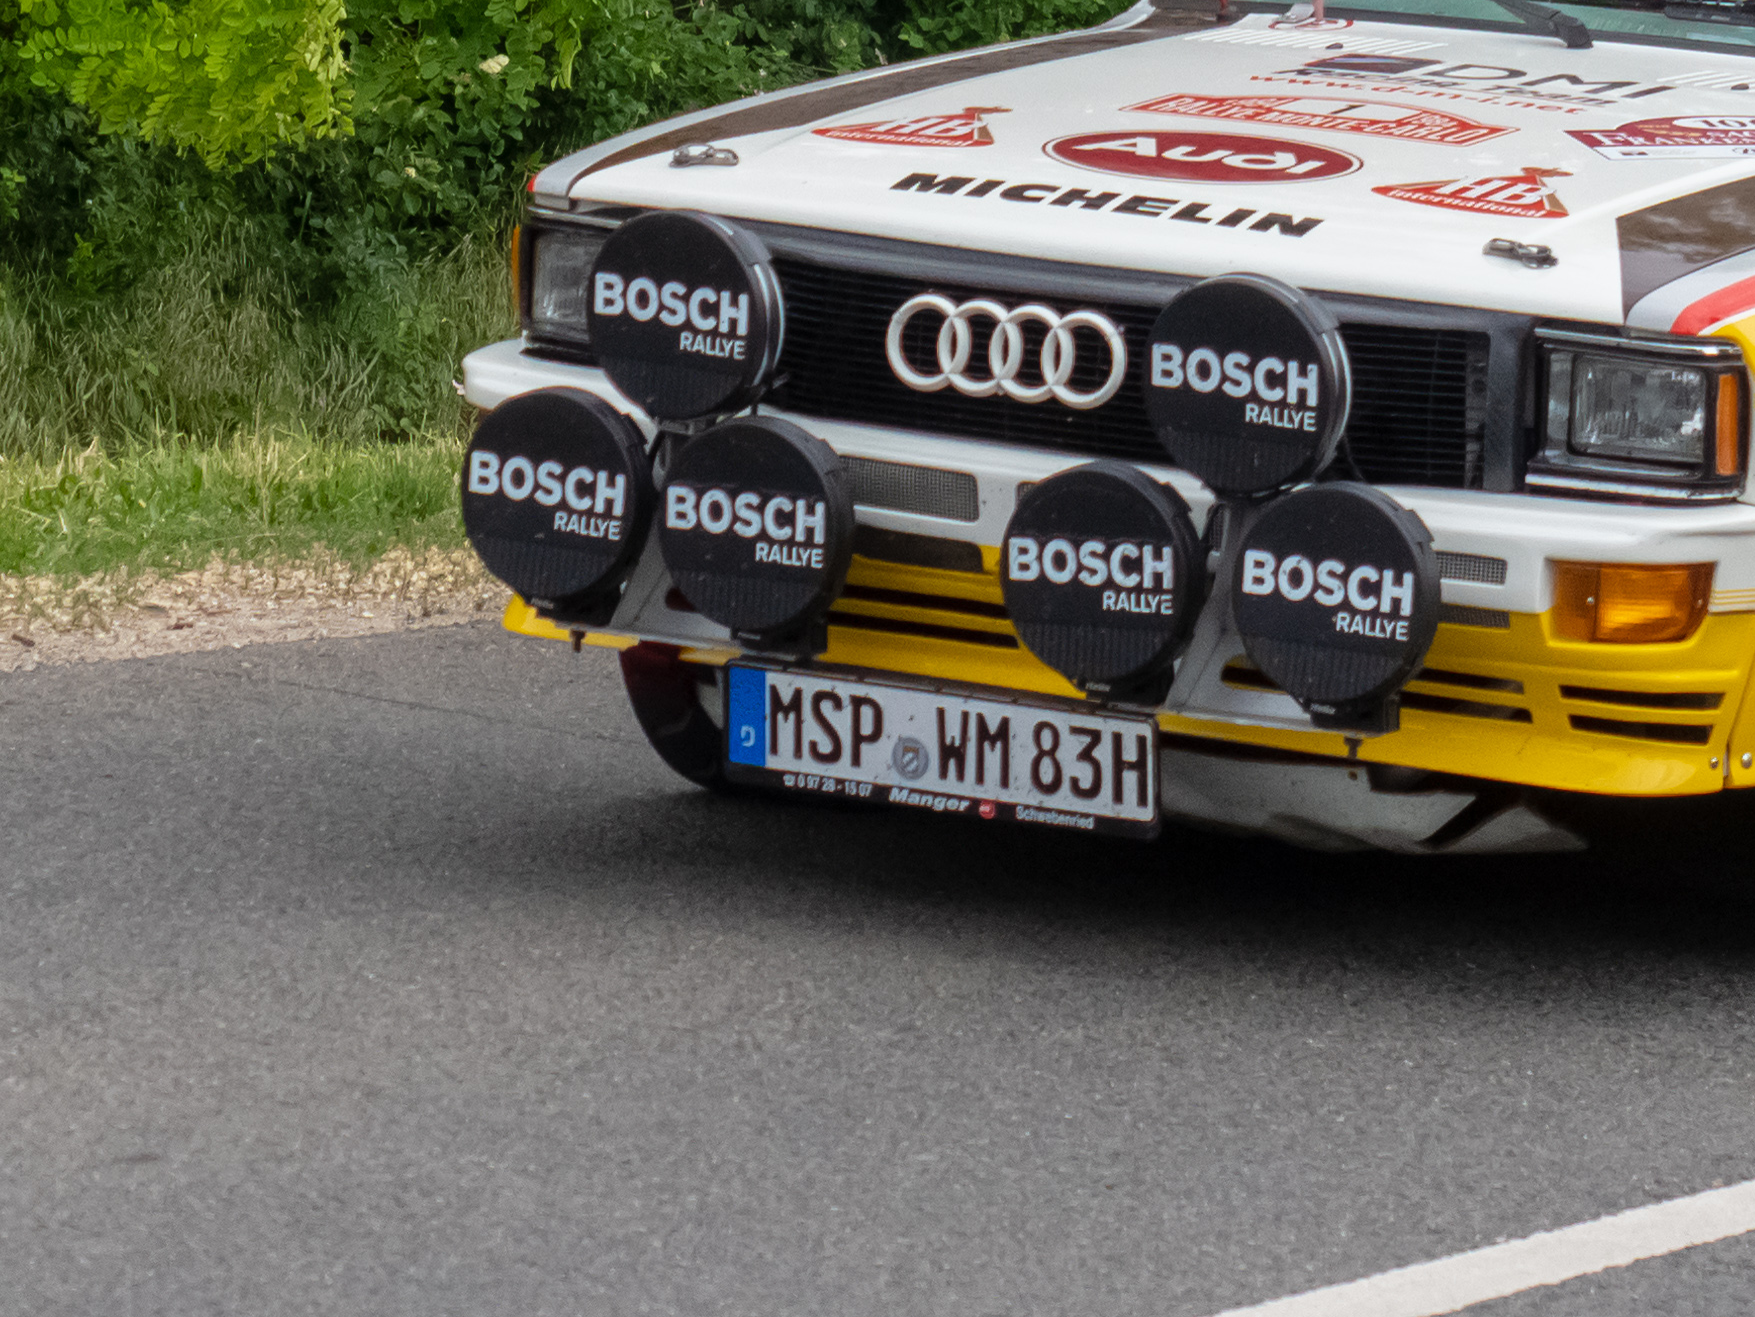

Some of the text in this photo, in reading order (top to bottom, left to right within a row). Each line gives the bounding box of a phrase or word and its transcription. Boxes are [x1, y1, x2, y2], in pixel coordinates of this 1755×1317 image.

[1422, 63, 1679, 99] DMI
[871, 116, 988, 136] HB
[1149, 96, 1490, 142] RALLYE MONTE-CARLO
[1071, 136, 1328, 176] Audi
[889, 171, 1326, 239] MICHELIN
[1388, 189, 1549, 218] international
[1432, 175, 1557, 205] HB
[594, 271, 751, 337] BOSCH
[679, 330, 747, 360] RALLYE
[1150, 342, 1318, 408] BOSCH
[1244, 403, 1317, 432] RALLYE
[468, 449, 626, 517] BOSCH
[553, 511, 622, 540] RALLYE
[666, 485, 826, 545] BOSCH
[755, 541, 824, 569] RALLYE
[1008, 536, 1175, 590] BOSCH
[1241, 548, 1415, 618] BOSCH
[1102, 590, 1174, 615] RALLYE
[1335, 611, 1409, 642] RALLYE
[768, 684, 1149, 808] MSP WM 83H
[889, 787, 970, 812] Manger
